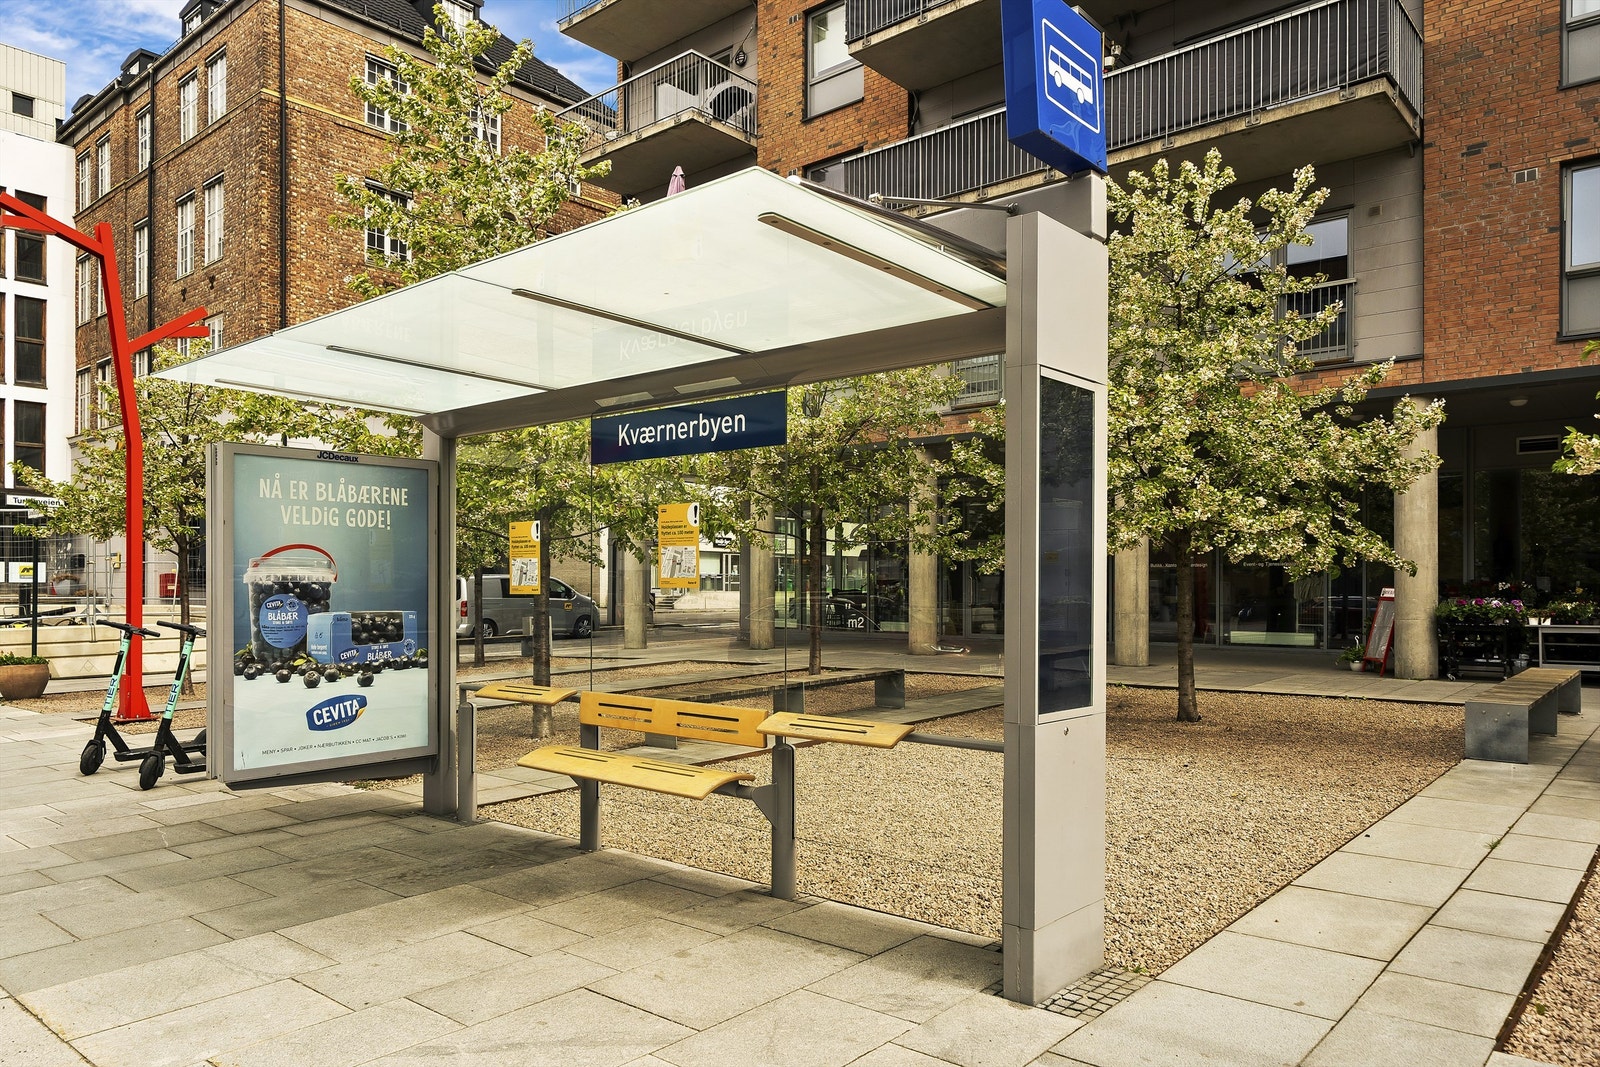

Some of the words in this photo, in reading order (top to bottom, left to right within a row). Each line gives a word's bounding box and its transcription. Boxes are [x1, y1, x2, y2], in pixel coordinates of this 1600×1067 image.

[618, 413, 746, 447] Kværnerbyen
[316, 451, 359, 463] JCDecaux
[259, 472, 282, 499] NÅ
[289, 480, 308, 500] ER
[316, 477, 409, 506] BLÅBÆRENE
[345, 508, 391, 531] GODE!
[267, 610, 298, 621] BLÅBÆR
[848, 616, 865, 628] m2
[340, 649, 357, 660] CEVITA
[367, 649, 393, 661] BLÅBÆR
[104, 677, 118, 707] TIER
[165, 683, 180, 712] TIER
[313, 699, 360, 726] CEVITA
[317, 740, 352, 748] NÆRBUTIKKEN
